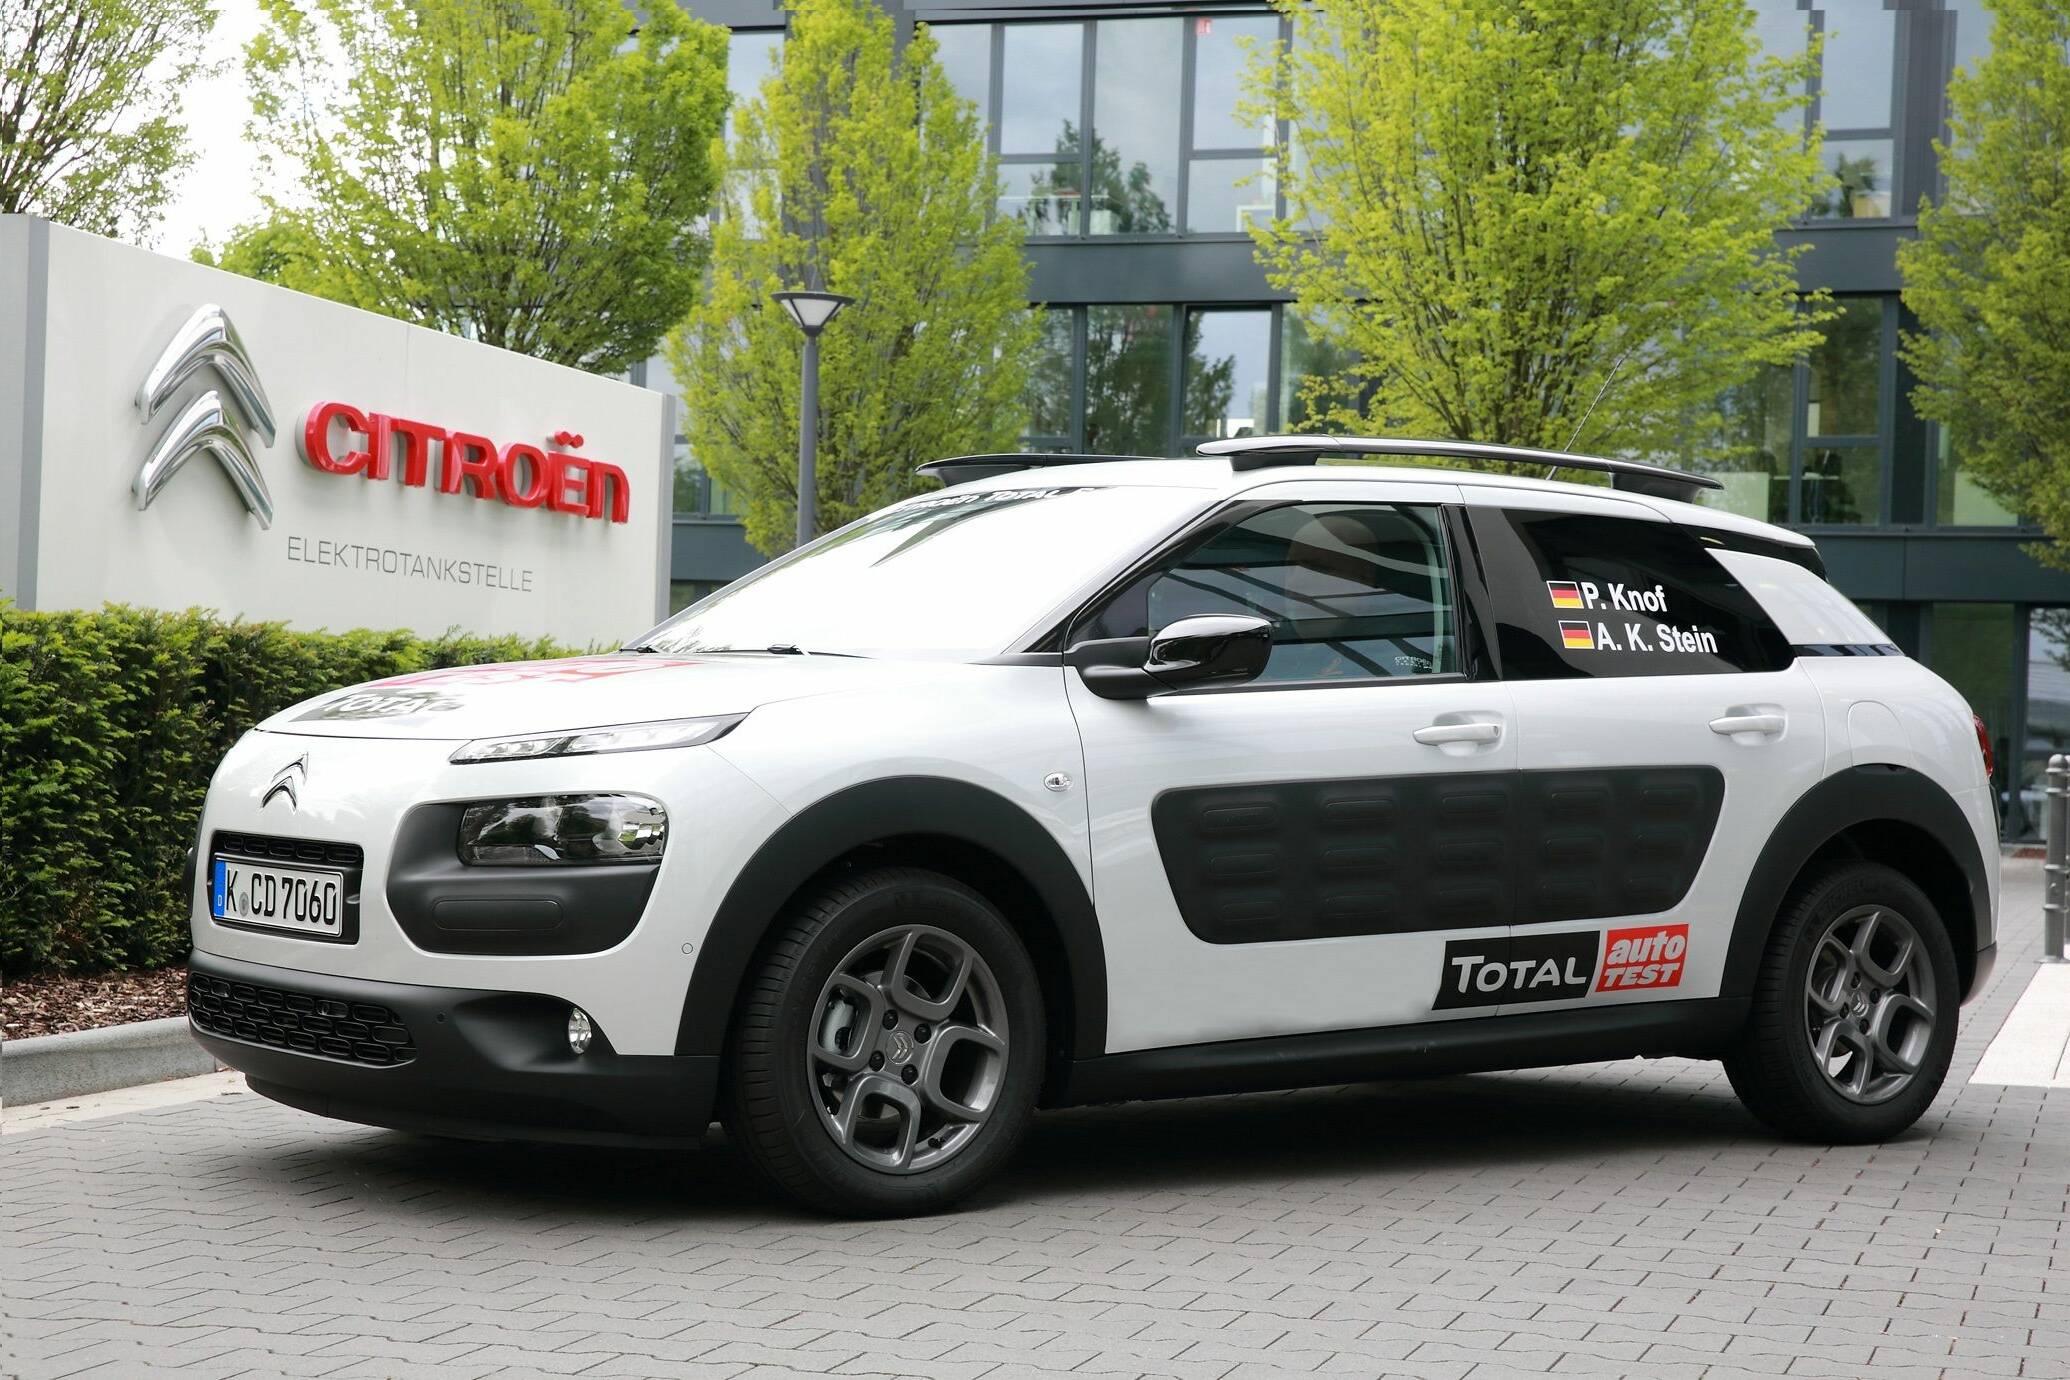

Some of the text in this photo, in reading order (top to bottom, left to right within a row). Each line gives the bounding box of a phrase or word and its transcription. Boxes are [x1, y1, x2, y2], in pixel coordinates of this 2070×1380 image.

[287, 535, 533, 592] ELEKTROTANKSTELLE
[1580, 581, 1668, 612] P. Knof
[1597, 622, 1719, 654] A. K. Stein
[1606, 930, 1686, 965] auto
[1451, 955, 1587, 993] TOTAL
[1603, 962, 1681, 988] TEST
